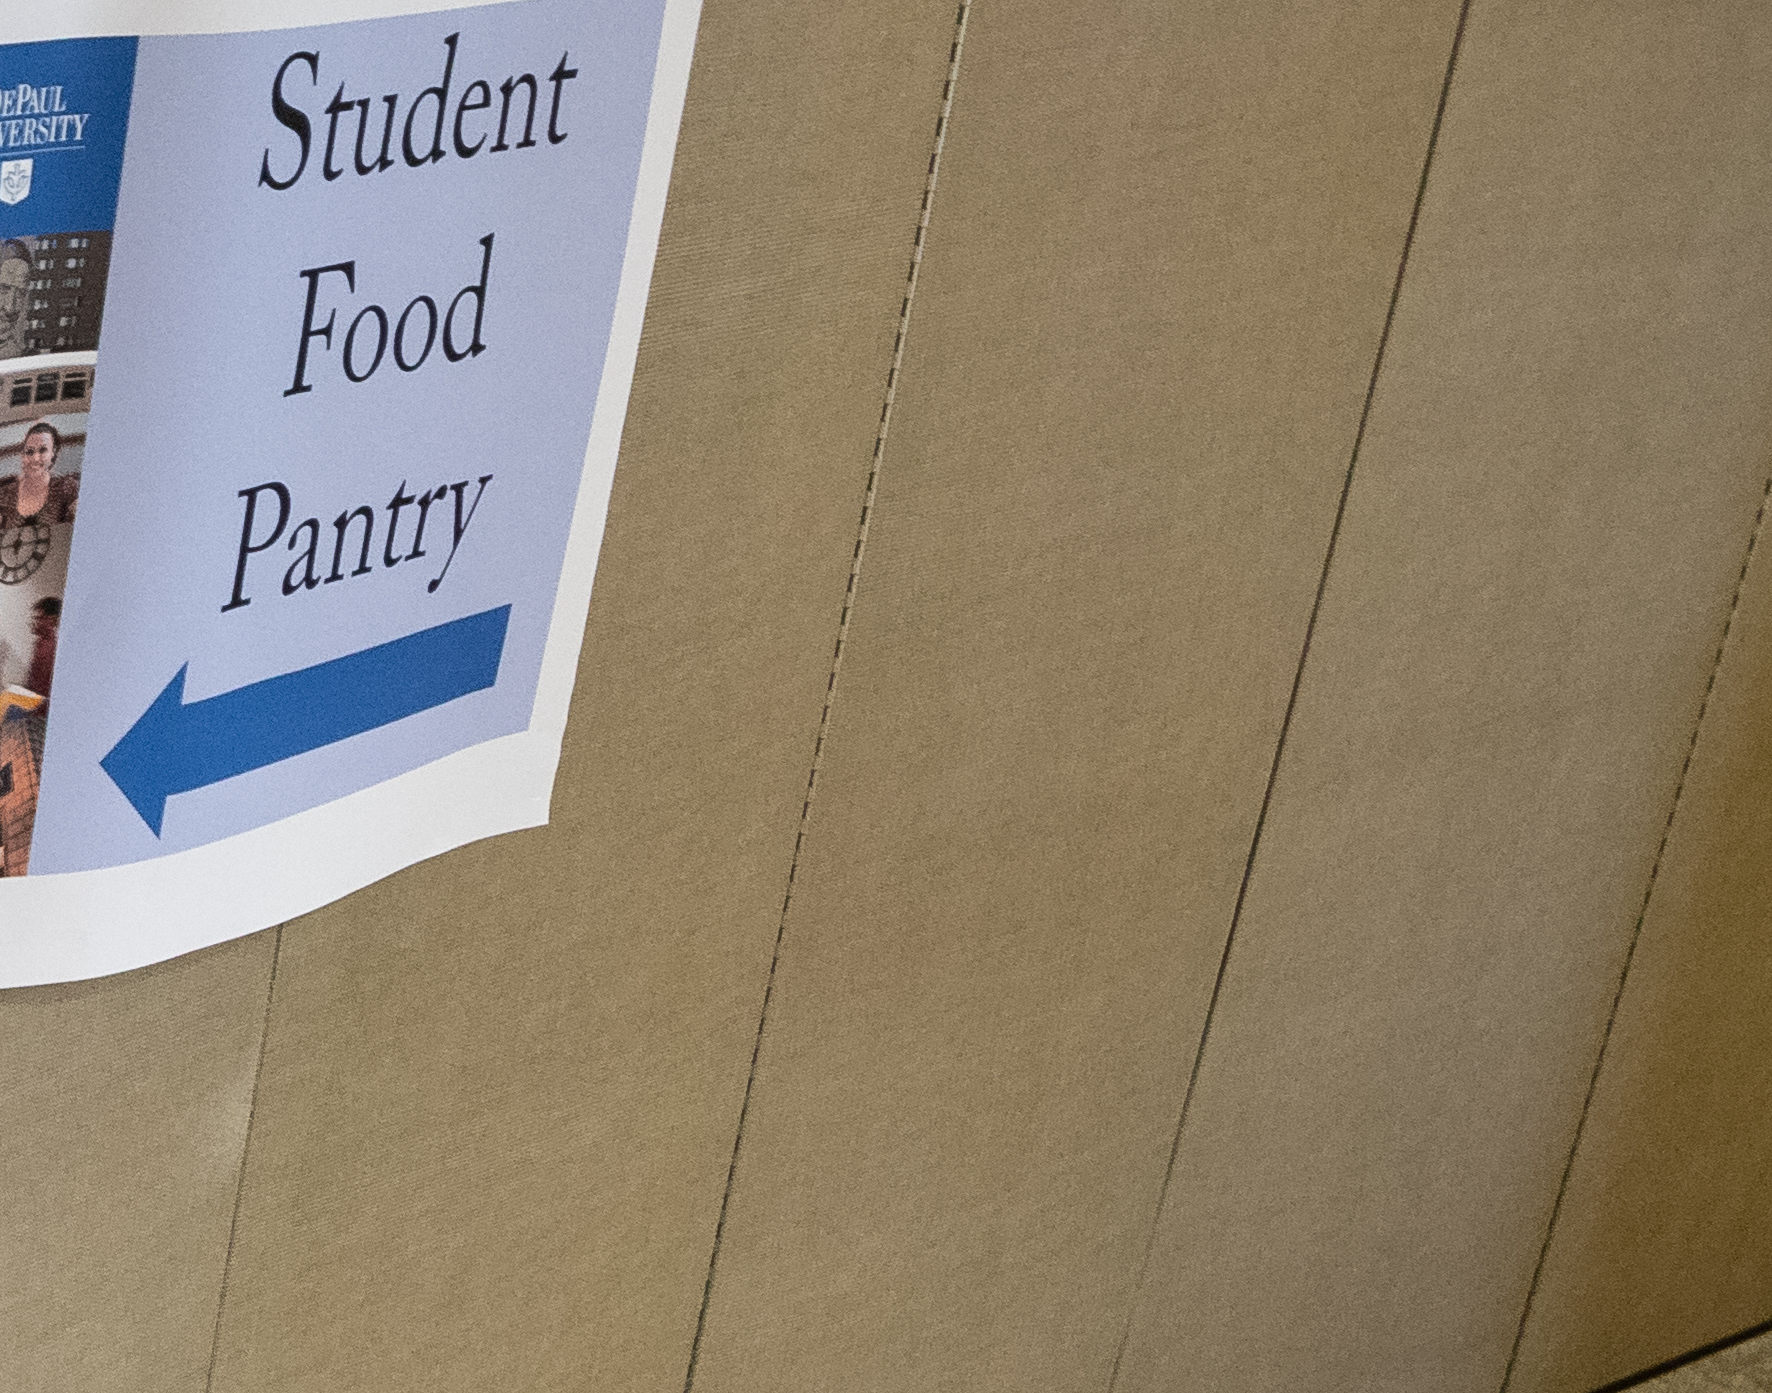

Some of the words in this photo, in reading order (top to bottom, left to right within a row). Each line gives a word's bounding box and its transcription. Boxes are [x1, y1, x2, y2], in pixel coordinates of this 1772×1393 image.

[259, 32, 578, 191] Student
[283, 233, 494, 397] Food
[221, 475, 494, 613] Pantry
